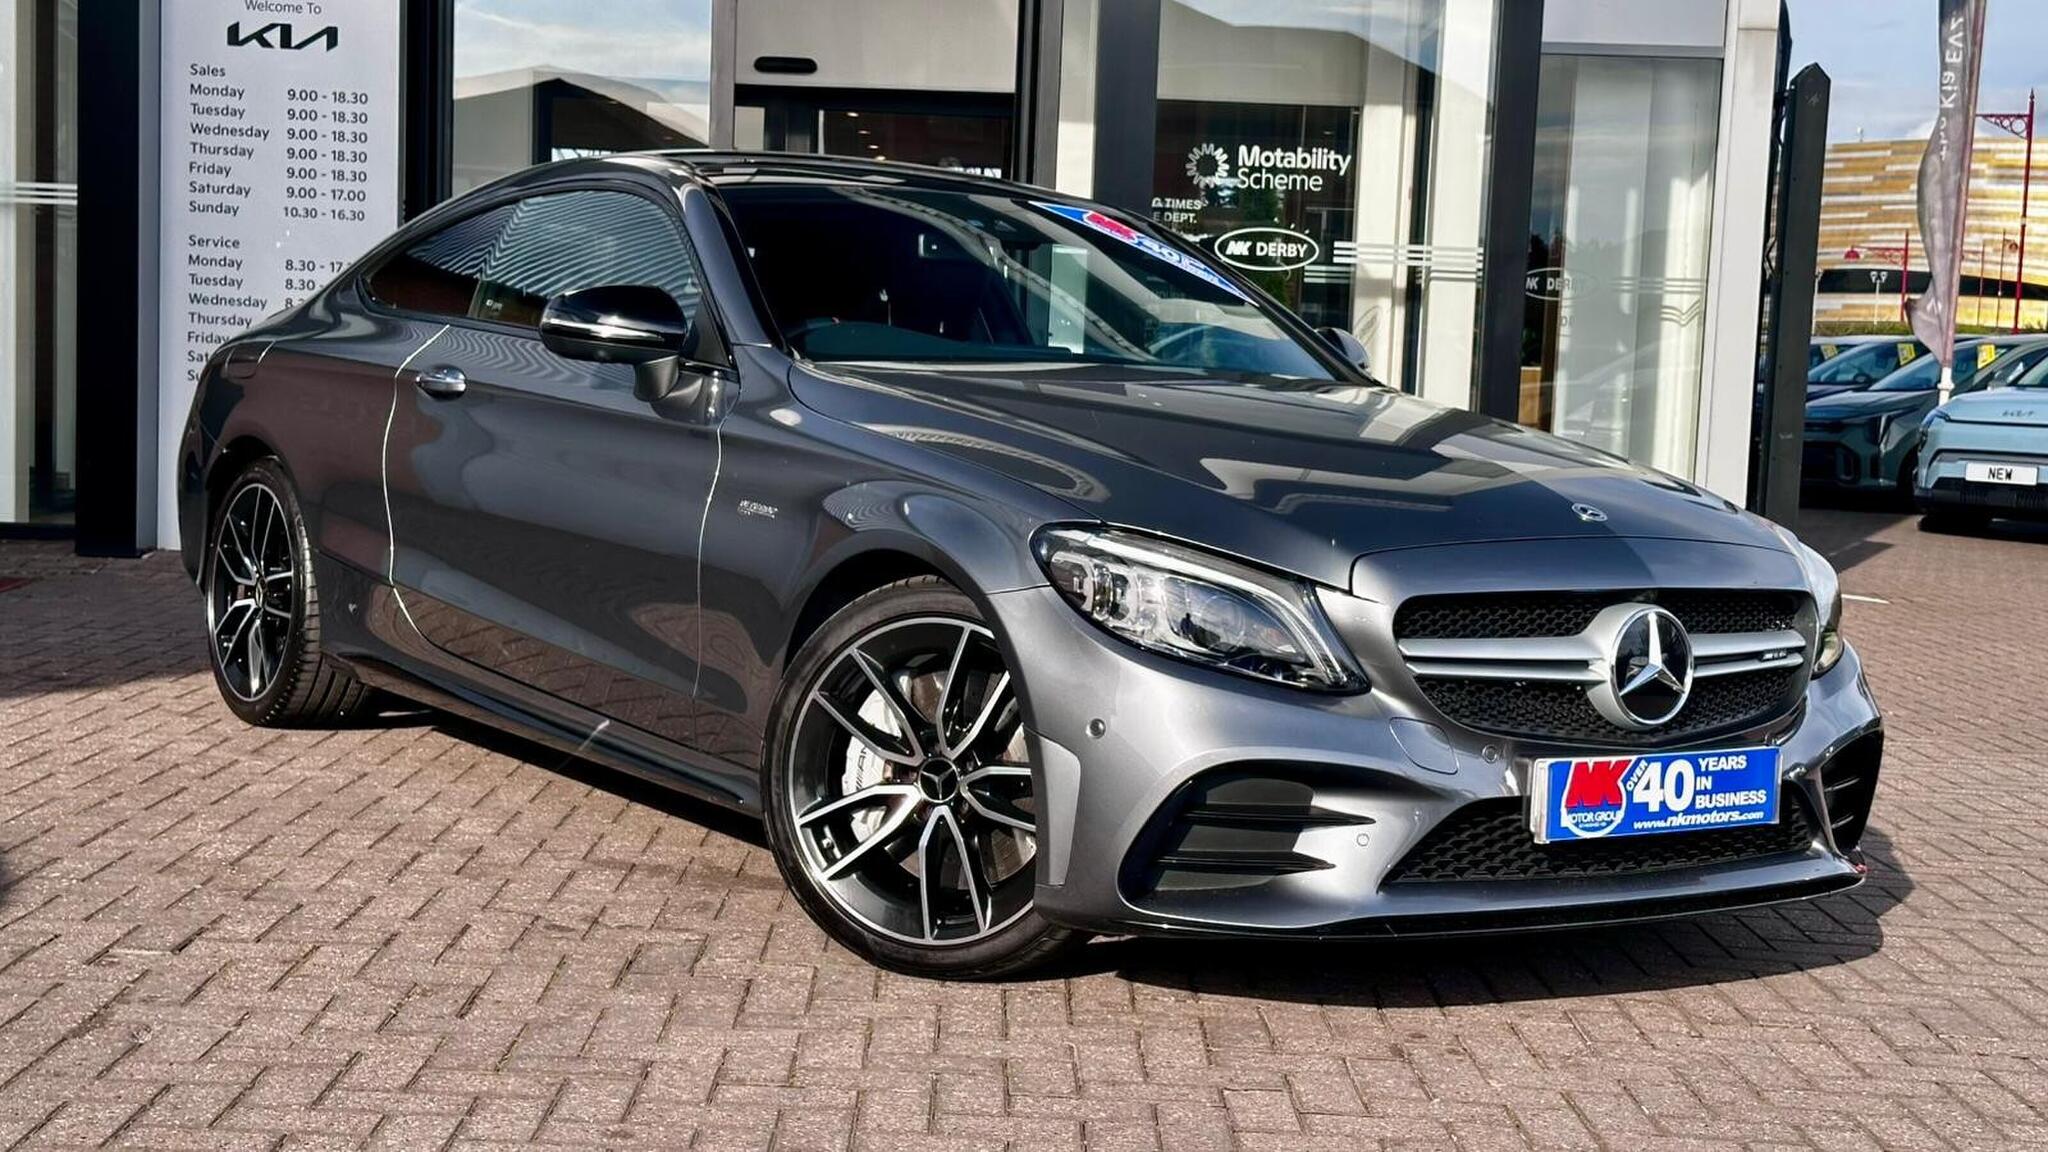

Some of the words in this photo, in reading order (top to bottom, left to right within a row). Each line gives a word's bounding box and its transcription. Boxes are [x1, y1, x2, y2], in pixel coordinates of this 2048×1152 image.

[245, 0, 303, 14] Welcome
[307, 2, 322, 14] To
[227, 22, 339, 51] KIA
[190, 64, 225, 76] Sales
[190, 83, 244, 100] Monday
[288, 89, 318, 102] 9.00
[332, 92, 368, 104] 18.30
[190, 103, 245, 119] Tuesday
[287, 108, 317, 121] 9.00
[332, 111, 368, 124] 18.30
[190, 122, 269, 141] Wednesday
[287, 128, 317, 141] 9.00
[332, 131, 367, 143] 18.30
[190, 142, 254, 159] Thursday
[287, 147, 317, 160] 9.00
[331, 150, 367, 163] 18.30
[1237, 145, 1352, 176] Motability
[189, 161, 231, 178] Friday
[287, 167, 317, 179] 9.00
[331, 170, 367, 182] 18.30
[1237, 168, 1323, 192] Scheme
[189, 181, 251, 198] Saturday
[287, 187, 317, 199] 9.00
[331, 189, 366, 202] 17.00
[189, 200, 239, 216] Sunday
[284, 207, 317, 218] 10.30
[331, 209, 365, 221] 16.30
[1164, 198, 1202, 210] TIMES
[1163, 211, 1197, 223] DEPT.
[189, 235, 240, 248] Service
[1255, 240, 1307, 258] DERBY
[189, 254, 242, 270] Monday
[285, 259, 315, 272] 8.30
[189, 273, 243, 289] Tuesday
[285, 279, 315, 290] 8.30
[189, 293, 267, 310] Wednesday
[189, 312, 251, 327] Thursday
[1988, 467, 2013, 481] NEW
[1698, 755, 1747, 771] YEARS
[1565, 759, 1632, 808] NK
[1625, 758, 1649, 791] OVER
[1696, 776, 1712, 790] IN
[1632, 759, 1695, 813] 40
[1695, 790, 1767, 810] BUSINESS
[1633, 810, 1765, 830] www.nkmotors.com
